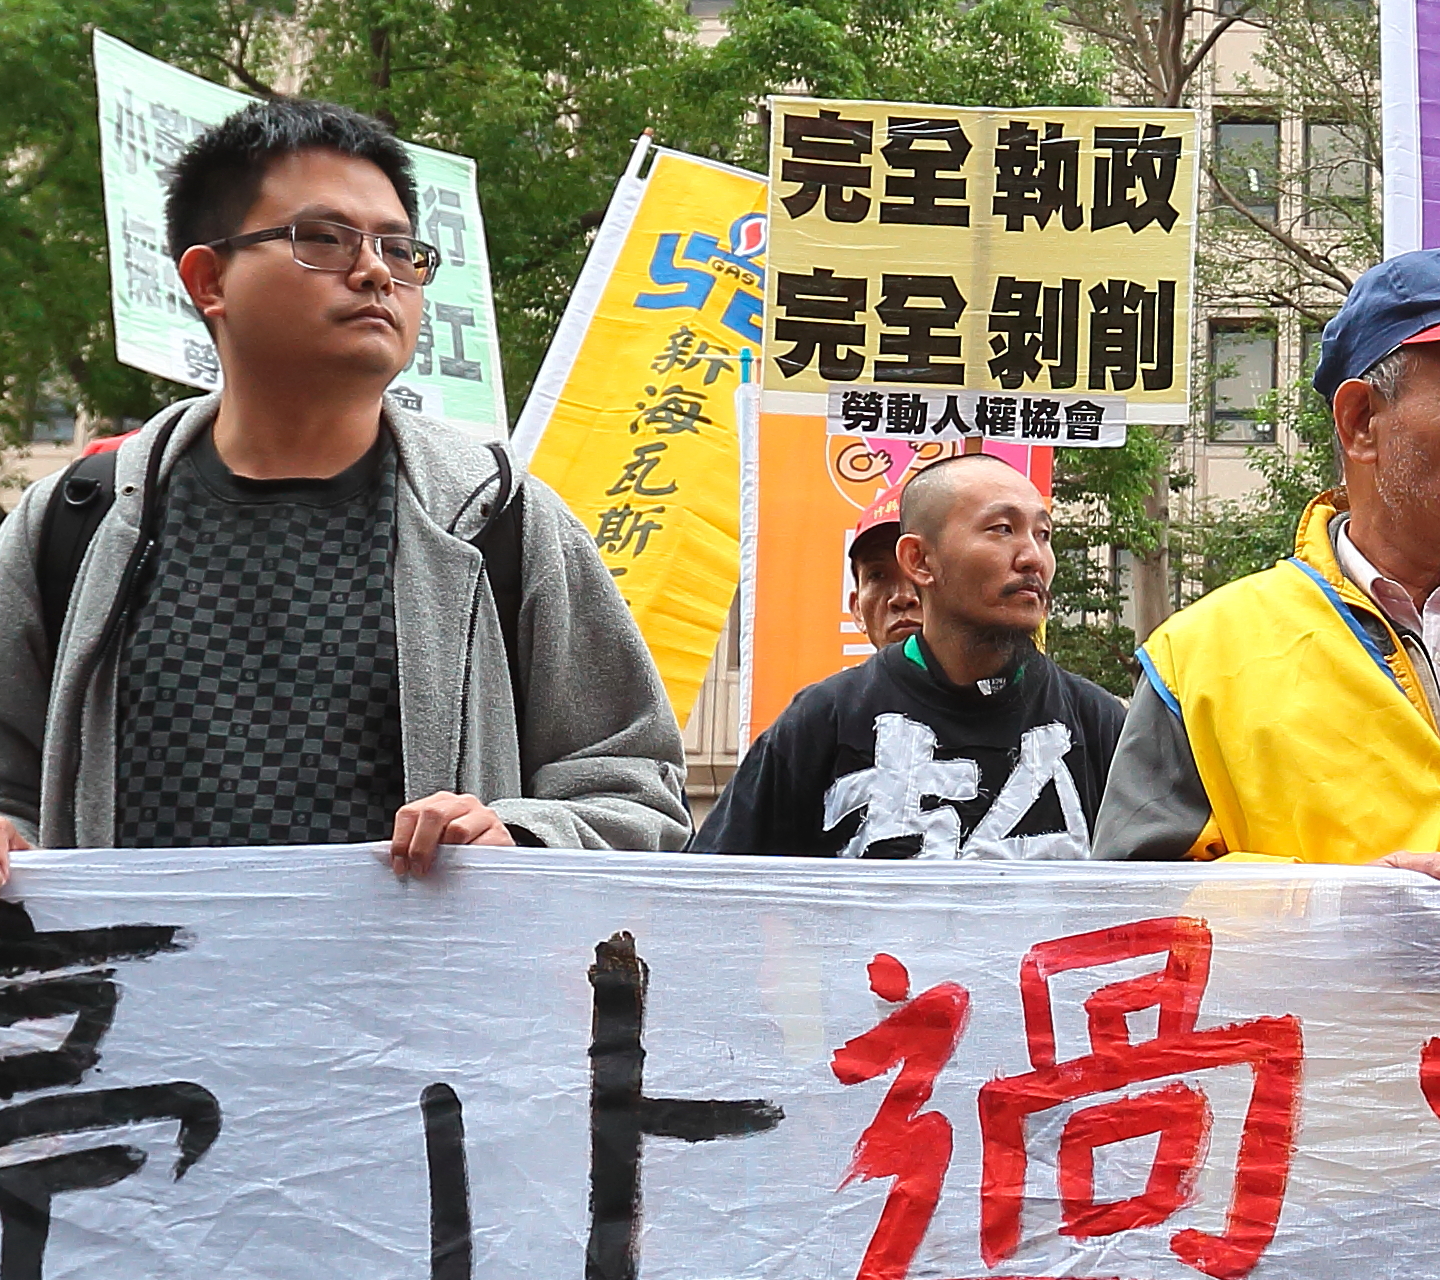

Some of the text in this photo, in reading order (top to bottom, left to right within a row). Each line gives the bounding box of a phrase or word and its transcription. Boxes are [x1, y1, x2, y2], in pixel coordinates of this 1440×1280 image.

[780, 109, 1183, 234] 完全執政
[711, 257, 755, 286] GAS
[594, 325, 735, 588] 新海瓦斯
[841, 390, 1106, 441] 勞動人權協會
